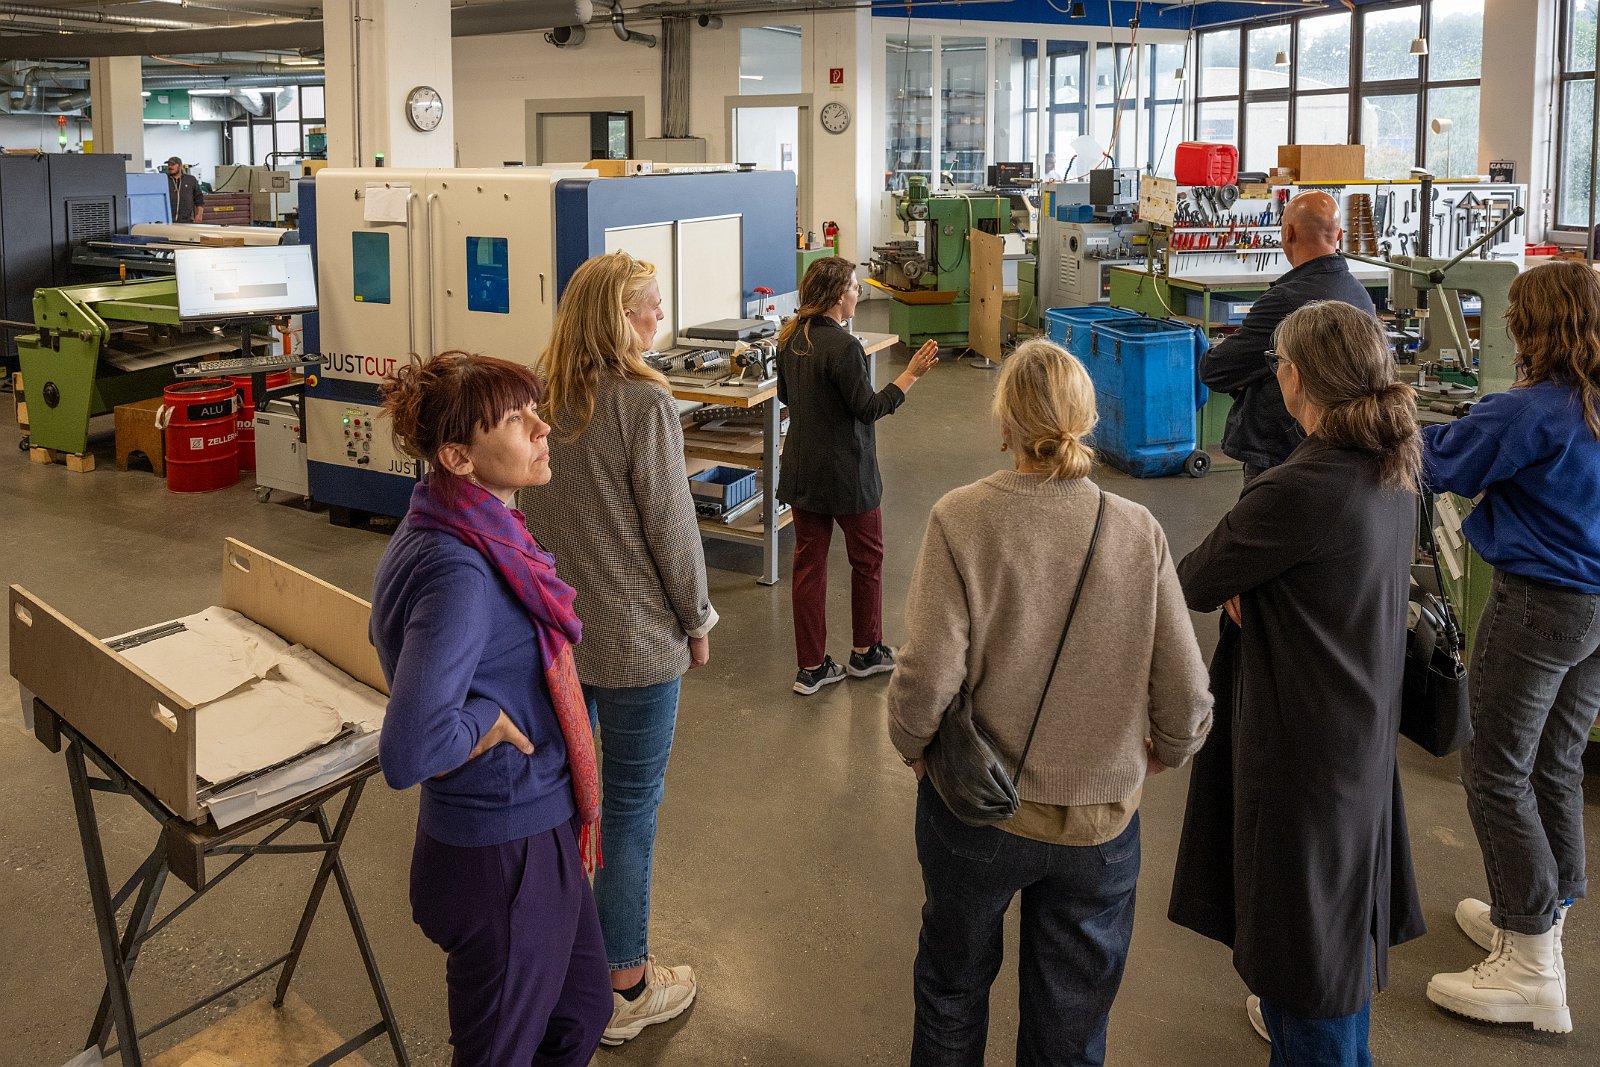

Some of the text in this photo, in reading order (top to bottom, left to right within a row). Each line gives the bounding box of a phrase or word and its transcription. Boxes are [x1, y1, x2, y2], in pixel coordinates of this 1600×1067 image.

[324, 352, 397, 377] JUSTCUT
[200, 404, 223, 416] ALU
[388, 459, 417, 476] JUST
